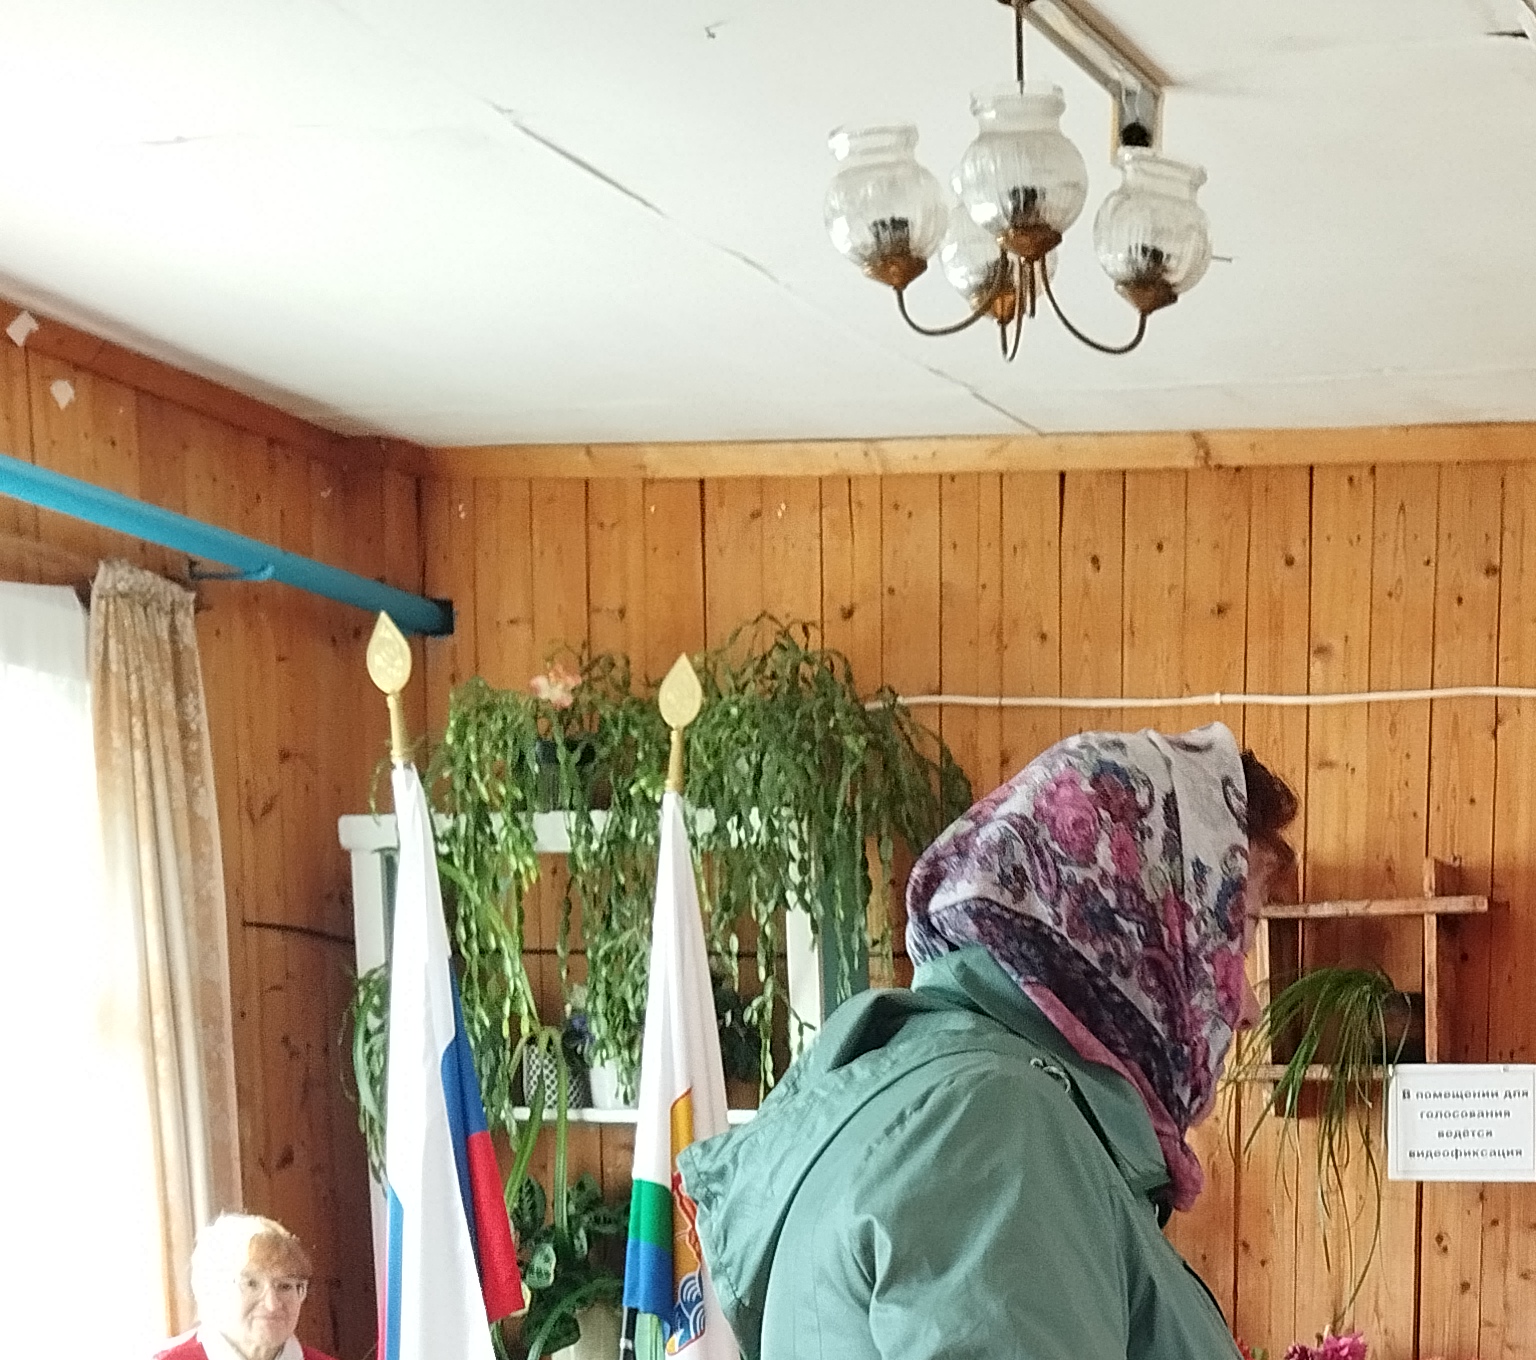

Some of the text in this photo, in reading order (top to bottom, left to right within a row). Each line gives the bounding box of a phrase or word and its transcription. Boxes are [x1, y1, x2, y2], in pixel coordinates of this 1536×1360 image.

[1402, 1089, 1529, 1101] В помещении для
[1419, 1109, 1511, 1119] голосования
[1408, 1148, 1523, 1160] видеофиксация
